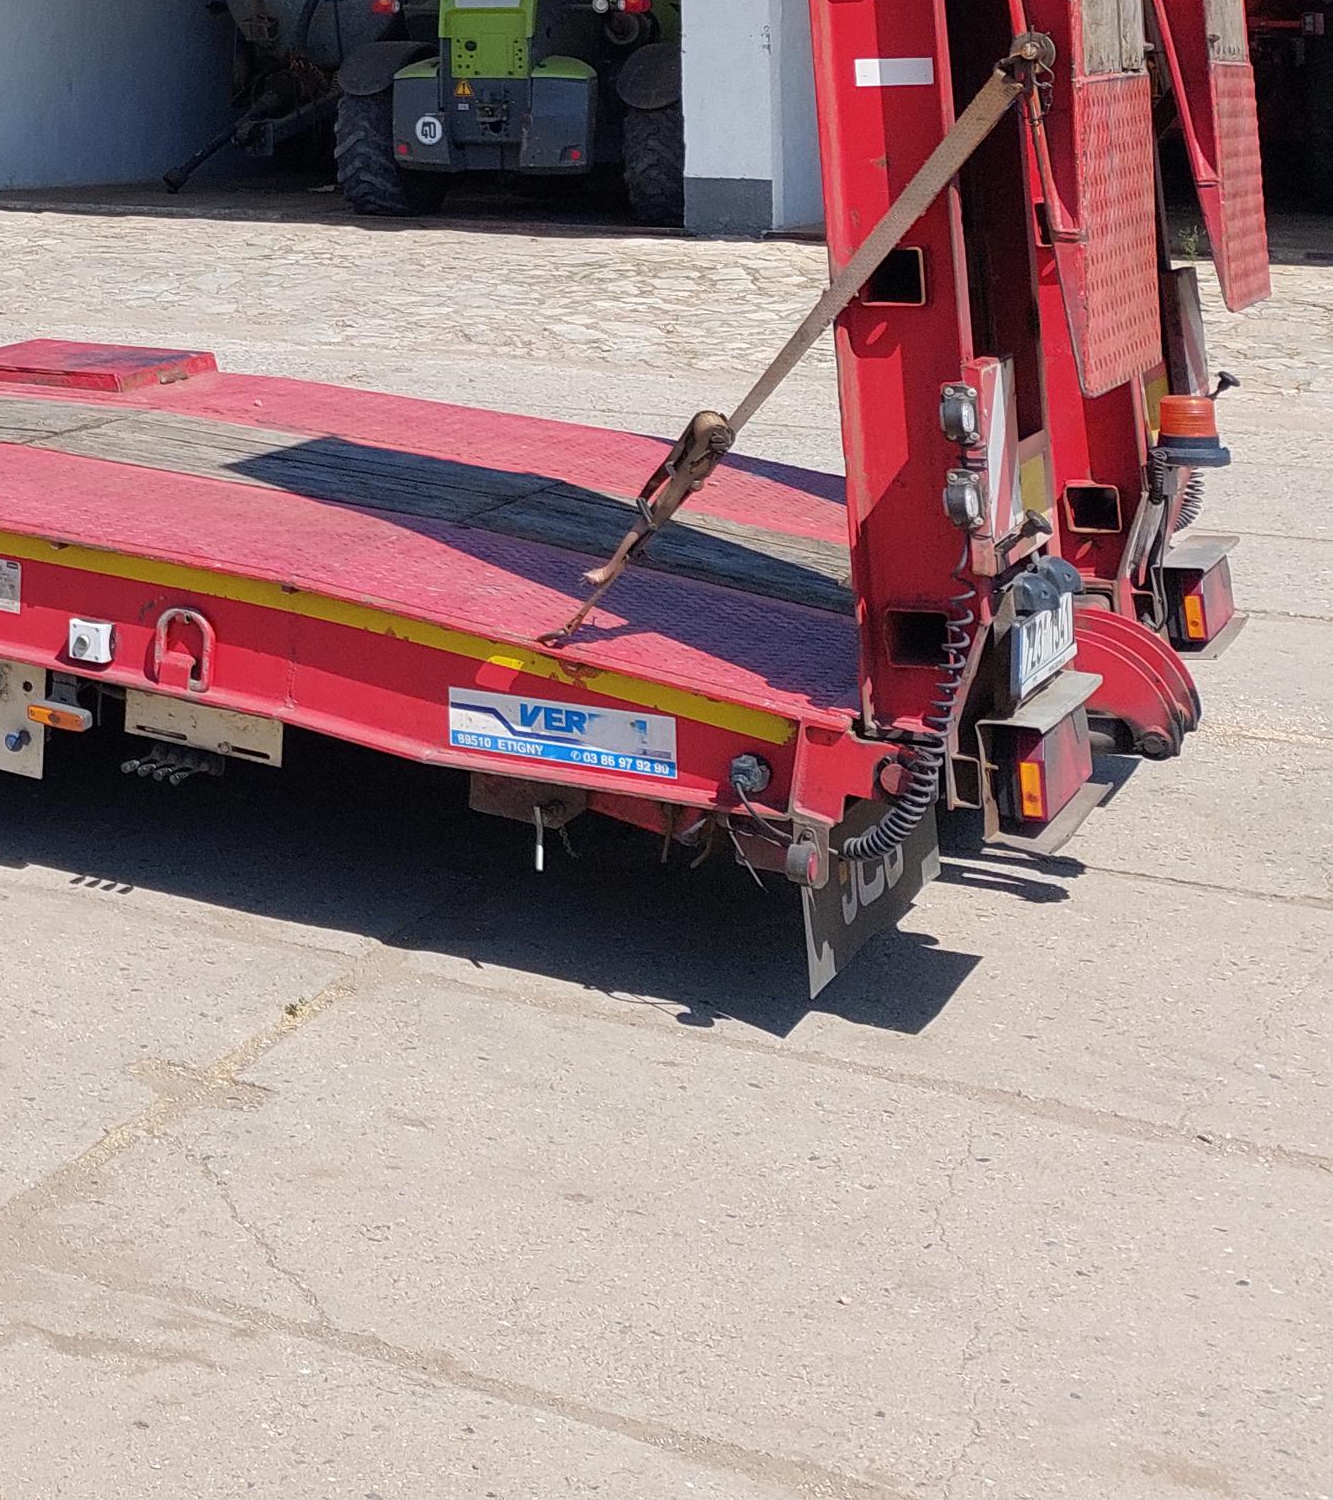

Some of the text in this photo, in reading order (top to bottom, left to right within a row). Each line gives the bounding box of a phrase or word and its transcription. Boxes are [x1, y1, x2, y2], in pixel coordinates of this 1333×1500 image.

[420, 121, 437, 139] 40
[457, 732, 544, 756] 89510 ETIGNY
[583, 752, 598, 765] 03
[600, 754, 616, 767] 86
[618, 757, 633, 770] 97
[635, 759, 651, 772] 92
